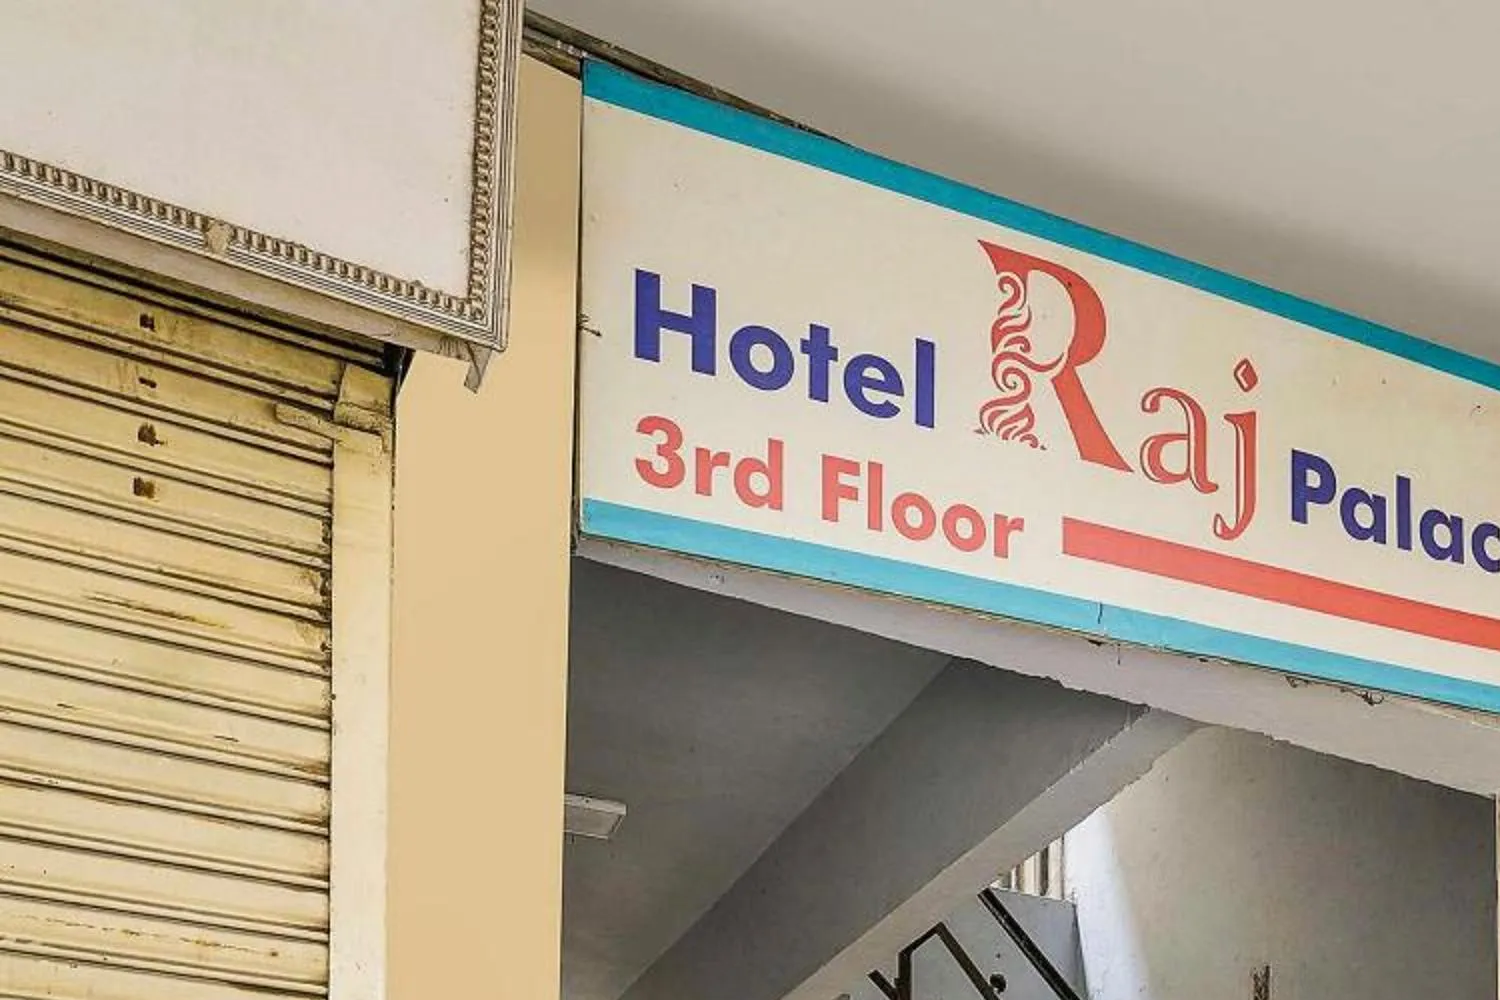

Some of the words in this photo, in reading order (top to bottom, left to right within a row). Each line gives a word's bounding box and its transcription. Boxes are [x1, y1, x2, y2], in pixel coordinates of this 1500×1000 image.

[634, 268, 936, 429] Hotel
[973, 239, 1259, 541] Raj
[634, 415, 784, 512] 3rd
[821, 453, 1025, 560] Floor
